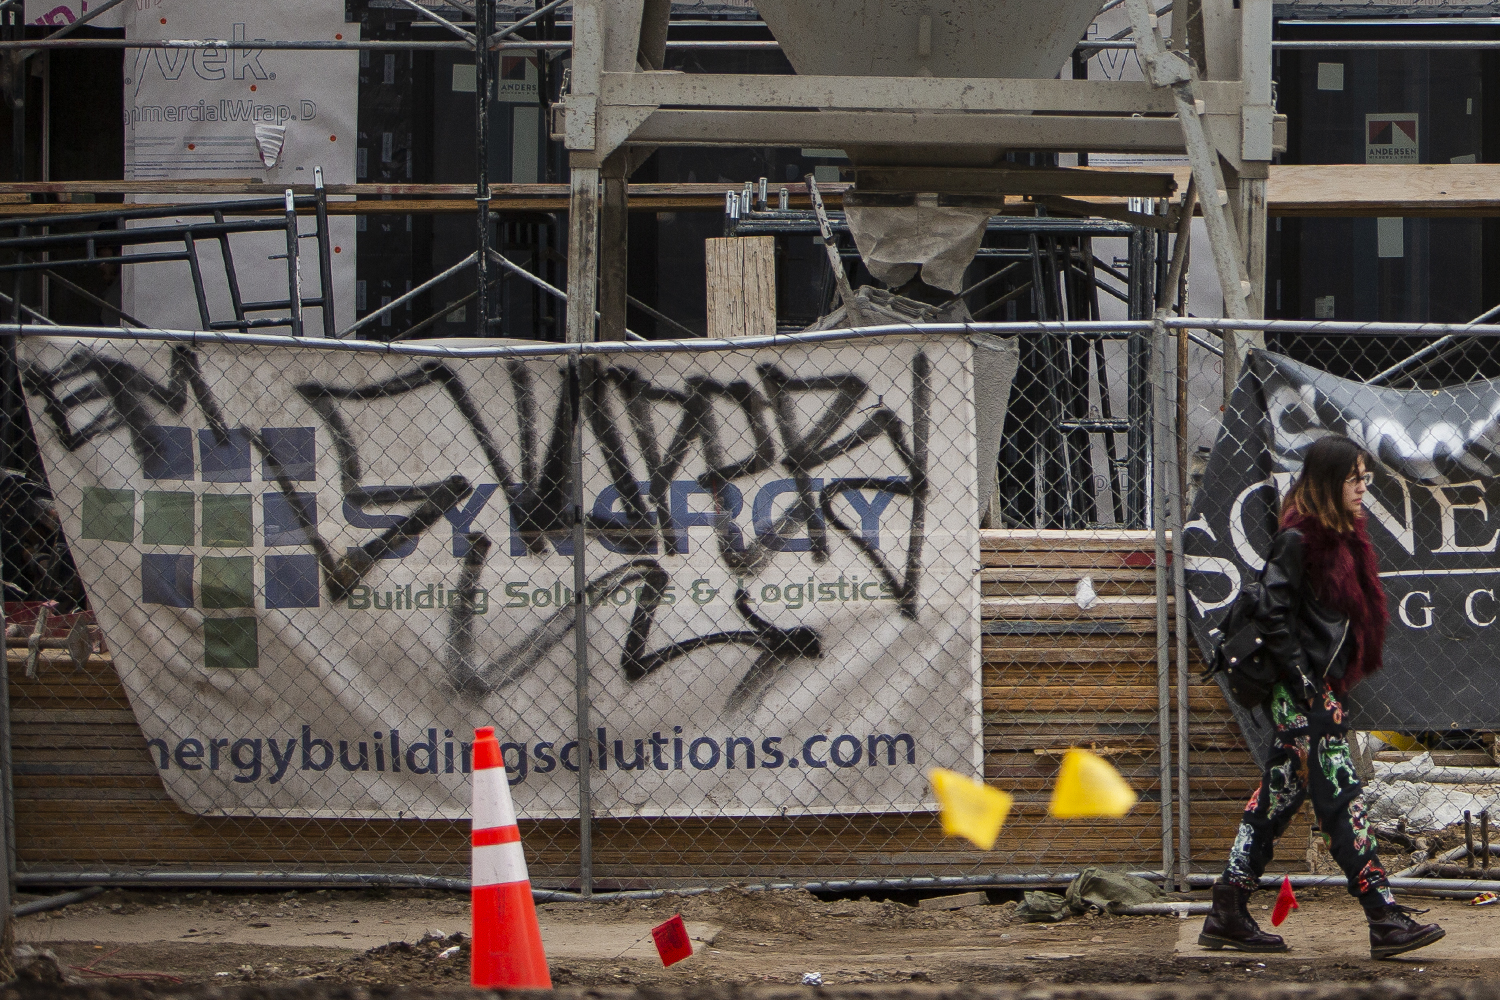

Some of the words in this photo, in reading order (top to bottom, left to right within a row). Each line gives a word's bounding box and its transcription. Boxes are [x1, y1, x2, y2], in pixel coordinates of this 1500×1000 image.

[501, 83, 538, 91] ANDERS
[1369, 147, 1417, 155] ANDERSEN
[692, 578, 719, 605] &
